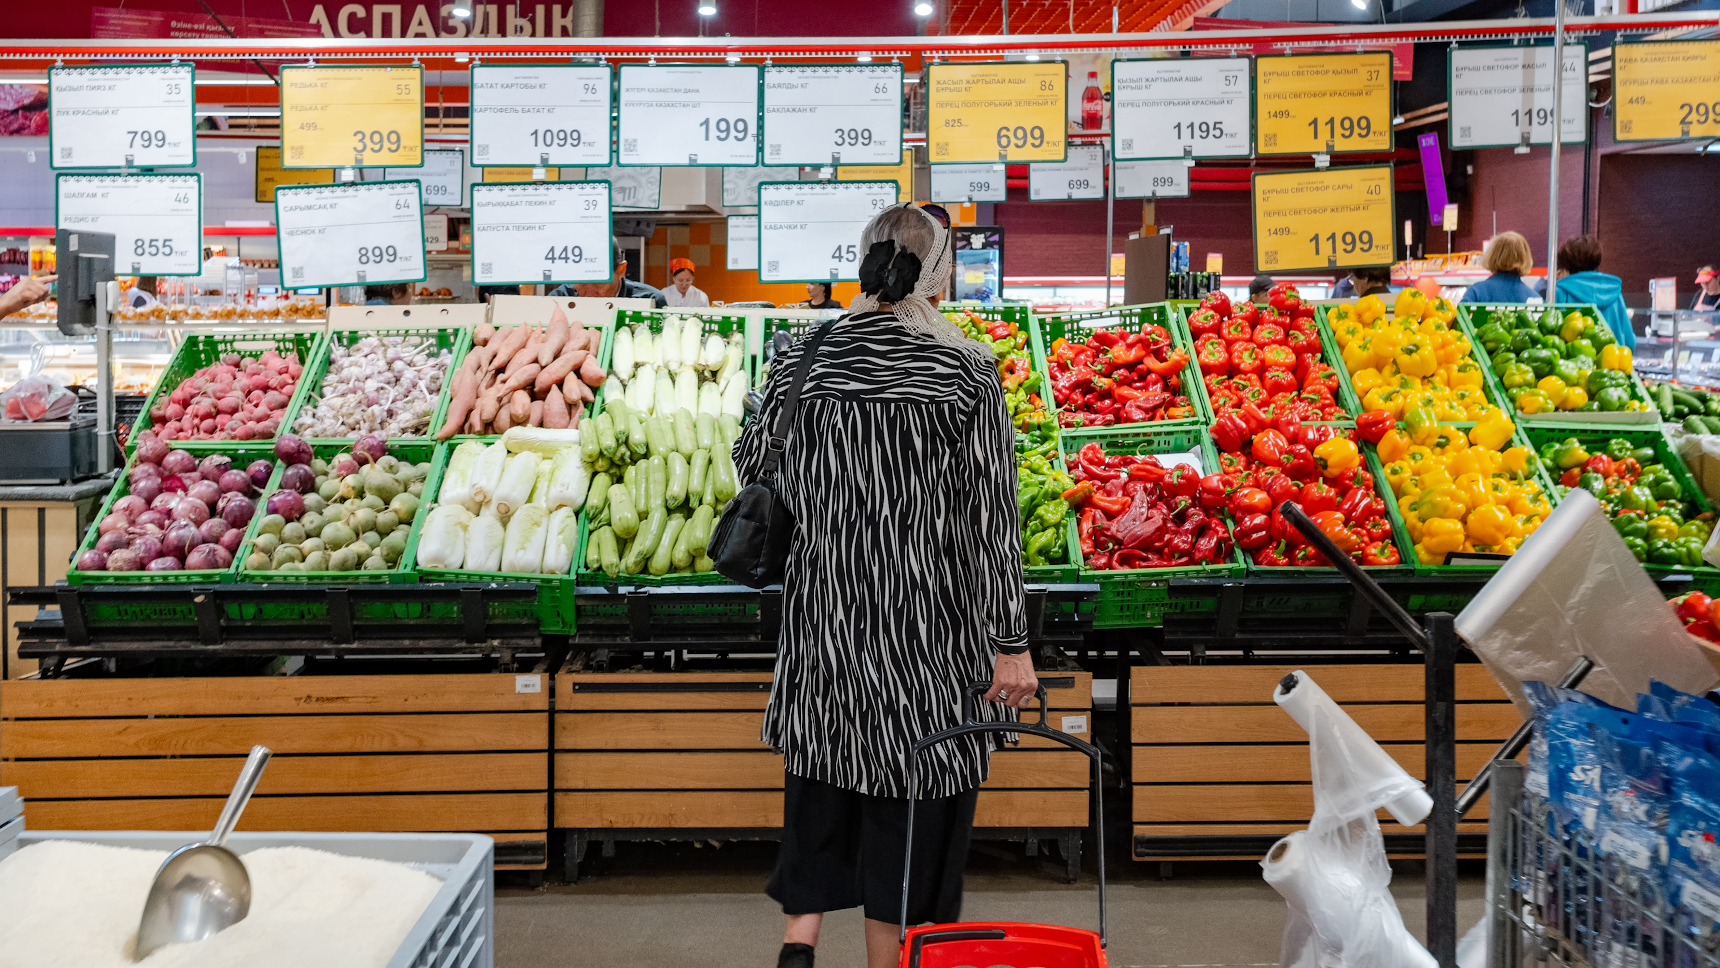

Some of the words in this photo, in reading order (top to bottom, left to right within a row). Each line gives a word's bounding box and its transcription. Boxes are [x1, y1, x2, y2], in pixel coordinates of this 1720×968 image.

[1291, 69, 1330, 77] СВЕТОФОР
[1562, 62, 1576, 73] 44
[1224, 75, 1238, 86] 57
[1366, 70, 1380, 81] 37
[1040, 80, 1054, 91] 86
[1620, 79, 1649, 87] ОГУРЦЫ
[1671, 76, 1711, 84] КАЗАХСТАН
[166, 84, 181, 95] 35
[396, 84, 411, 95] 55
[583, 83, 597, 94] 96
[874, 82, 888, 94] 66
[1518, 86, 1550, 94] ЗЕЛЕНЫЙ
[1288, 91, 1328, 99] СВЕТОФОР
[1329, 90, 1364, 98] КРАСНЫЙ
[961, 100, 1013, 108] ПОЛУГОРЬКИЙ
[1014, 99, 1049, 107] ЗЕЛЕНЫЙ
[1192, 98, 1225, 106] КРАСНЫЙ
[1628, 96, 1646, 105] 449
[72, 108, 109, 116] КРАСНЫЙ
[1266, 110, 1290, 119] 1499
[299, 122, 318, 131] 499
[944, 119, 963, 128] 825
[1308, 116, 1371, 140] 1199
[699, 117, 749, 142] 199
[1173, 121, 1224, 140] 1195
[126, 130, 166, 149] 799
[353, 130, 401, 153] 399
[530, 129, 581, 147] 1099
[834, 128, 873, 147] 399
[996, 125, 1045, 149] 699
[969, 181, 990, 192] 599
[1068, 179, 1089, 190] 699
[1152, 177, 1174, 187] 899
[425, 185, 447, 196] 699
[1291, 185, 1330, 194] СВЕТОФОР
[1366, 184, 1381, 196] 40
[174, 192, 190, 204] 46
[395, 199, 410, 210] 64
[583, 200, 598, 211] 39
[871, 199, 885, 210] 93
[1263, 210, 1287, 218] ПЕРЕЦ
[1288, 208, 1328, 216] СВЕТОФОР
[1330, 205, 1360, 213] ЖЕЛТЫЙ
[1267, 226, 1291, 236] 1499
[134, 239, 174, 257] 855
[1309, 230, 1374, 256] 1199
[358, 245, 398, 265] 899
[544, 245, 583, 264] 449
[831, 244, 857, 263] 45
